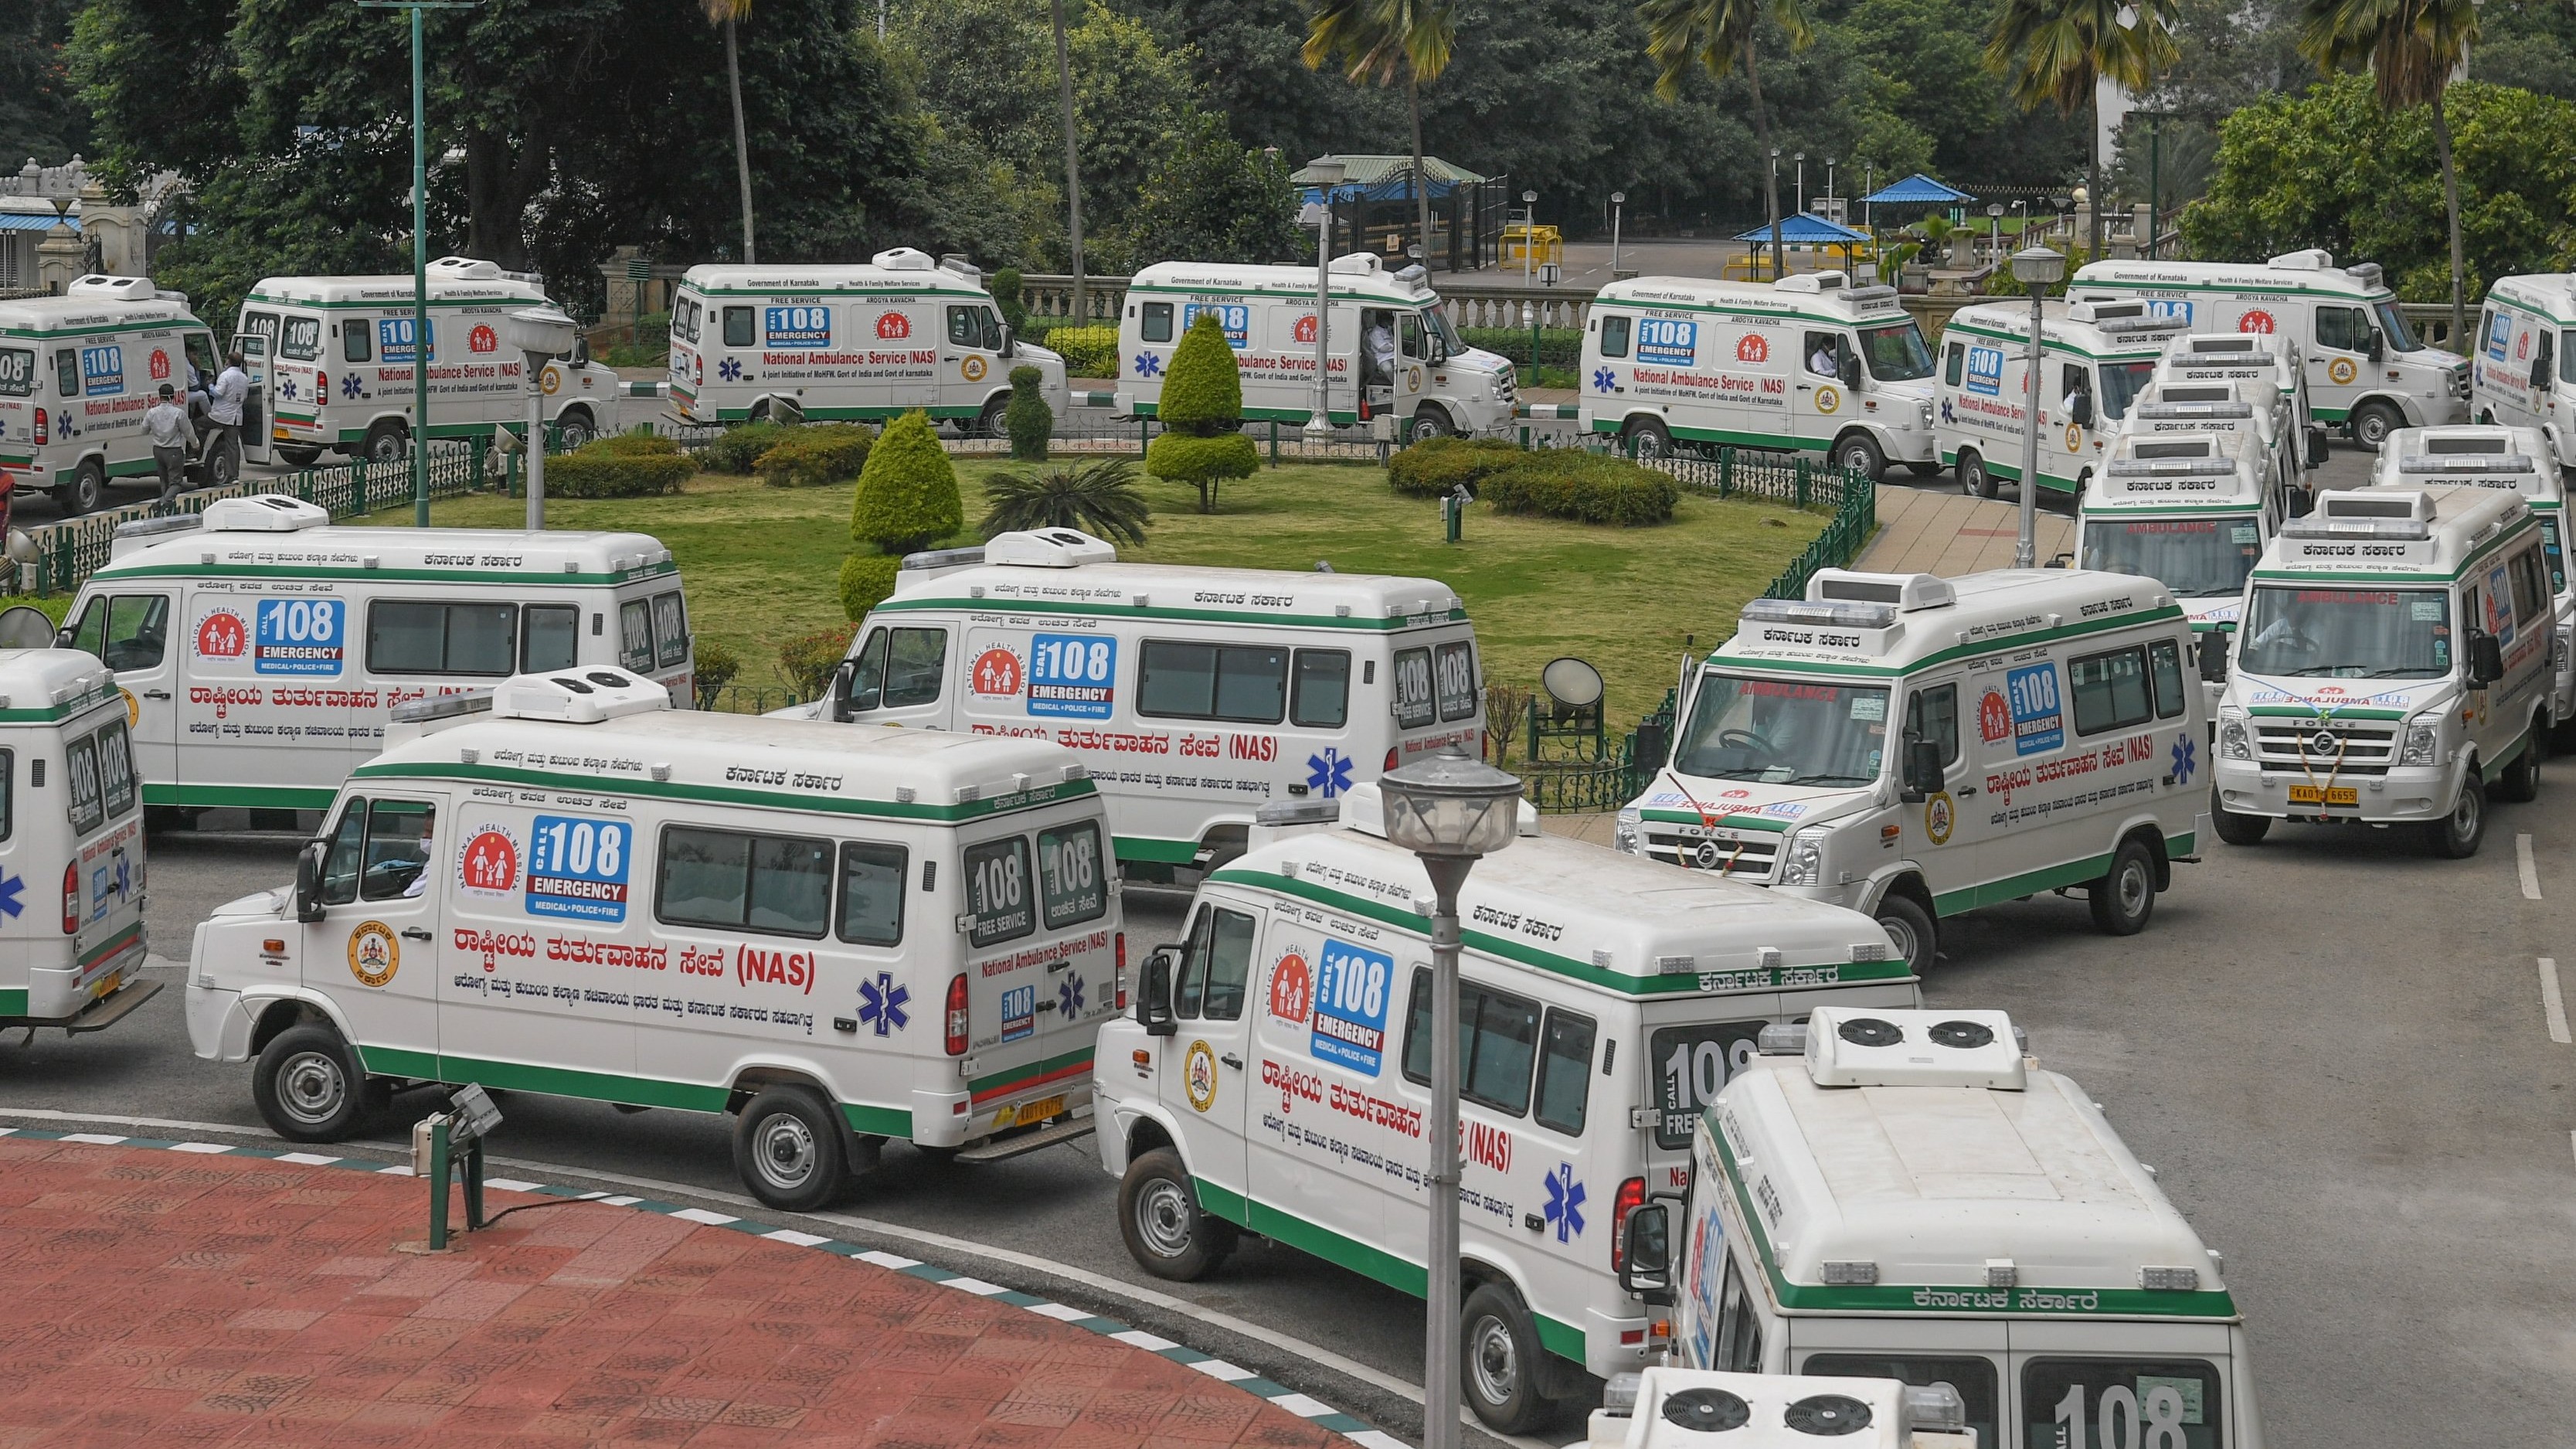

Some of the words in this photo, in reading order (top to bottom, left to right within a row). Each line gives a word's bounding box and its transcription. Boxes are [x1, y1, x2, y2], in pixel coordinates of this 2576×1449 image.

[1171, 277, 1205, 285] Government
[2114, 272, 2148, 282] Government
[2150, 272, 2156, 281] of
[2158, 273, 2187, 281] Karnataka
[1632, 290, 1662, 301] Government
[1670, 292, 1694, 301] Karnataka
[777, 308, 825, 330] 108
[1650, 322, 1691, 345] 108
[89, 348, 120, 374] 108
[763, 352, 804, 365] National
[808, 352, 864, 365] Ambulance
[869, 351, 906, 364] Service
[909, 350, 936, 365] (NAS)
[1640, 345, 1692, 356] EMERGENCY
[1974, 351, 1997, 374] 108
[379, 367, 413, 382] National
[464, 365, 494, 378] Service
[499, 362, 522, 379] (NAS)
[1633, 368, 1669, 383] National
[1671, 371, 1718, 386] Ambulance
[1721, 376, 1754, 391] Service
[1761, 378, 1785, 393] (NAS)
[85, 401, 110, 416] National
[112, 399, 144, 412] Ambulance
[424, 553, 475, 566] ಕರ್ನಾಟಕ
[481, 554, 522, 567] ಸರ್ಕಾರ
[1194, 589, 1246, 606] ಕರ್ನಾಟಕ
[1251, 592, 1294, 607] ಸರ್ಕಾರ
[2296, 592, 2398, 605] AMBULANCE
[269, 601, 333, 641] 108
[263, 648, 340, 659] EMERGENCY
[1036, 642, 1046, 677] CALL
[1046, 640, 1110, 681] 108
[272, 684, 378, 709] ತುರ್ತುವಾಹನ
[1032, 685, 1106, 700] EMERGENCY
[1739, 682, 1838, 702] AMBULANCE
[2011, 679, 2022, 716] CALL
[2019, 670, 2054, 714] 108
[2018, 716, 2059, 736] EMERGENCY
[2292, 719, 2357, 728] FORCE
[1057, 726, 1169, 755] ತುರ್ತುವಾಹನ
[1180, 733, 1221, 759] ಸೇವೆ
[1229, 733, 1278, 762] (NAS)
[2127, 733, 2153, 763] (NAS)
[726, 764, 787, 785] ಕರ್ನಾಟಕ
[792, 769, 844, 791] ಸರ್ಕಾರ
[2296, 788, 2327, 801] KA01
[2331, 790, 2355, 801] 6655
[1678, 827, 1739, 838] FORCE
[456, 832, 477, 889] NATIONAL
[479, 823, 512, 838] HEALTH
[511, 838, 523, 892] MISSION
[535, 825, 549, 869] CALL
[549, 822, 622, 877] 108
[1048, 837, 1093, 895] 108
[534, 877, 622, 900] EMERGENCY
[975, 853, 1021, 913] 108
[535, 901, 568, 912] MEDICAL
[571, 904, 599, 914] POLICE
[602, 906, 619, 916] FIRE
[977, 918, 996, 937] FREE
[997, 910, 1027, 932] SERVICE
[1473, 903, 1520, 930] ಕರ್ನಾಟಕ
[1522, 913, 1565, 942] ಸರ್ಕಾರ
[546, 931, 668, 971] ತುರ್ತುವಾಹನ
[680, 946, 724, 977] ಸೇವೆ
[736, 943, 815, 995] (NAS)
[981, 955, 1014, 978] National
[1015, 946, 1058, 974] Ambulance
[1059, 938, 1087, 960] Service
[1088, 930, 1108, 955] (NAS)
[1321, 952, 1334, 1002] CALL
[1334, 955, 1385, 1018] 108
[1699, 970, 1771, 991] ಕರ್ನಾಟಕ
[1780, 965, 1839, 985] ಸರ್ಕಾರ
[1317, 1015, 1380, 1049] EMERGENCY
[1315, 1039, 1337, 1055] MEDICAL
[1341, 1046, 1361, 1062] POLICE
[1364, 1054, 1376, 1066] FIRE
[1330, 1082, 1421, 1138] ತುರ್ತುವಾಹನ
[1470, 1127, 1512, 1175] (NAS)
[1913, 1287, 2008, 1308] ಕರ್ನಾಟಕ
[2019, 1289, 2098, 1311] ಸರ್ಕಾರ
[2055, 1383, 2187, 1449] 108
